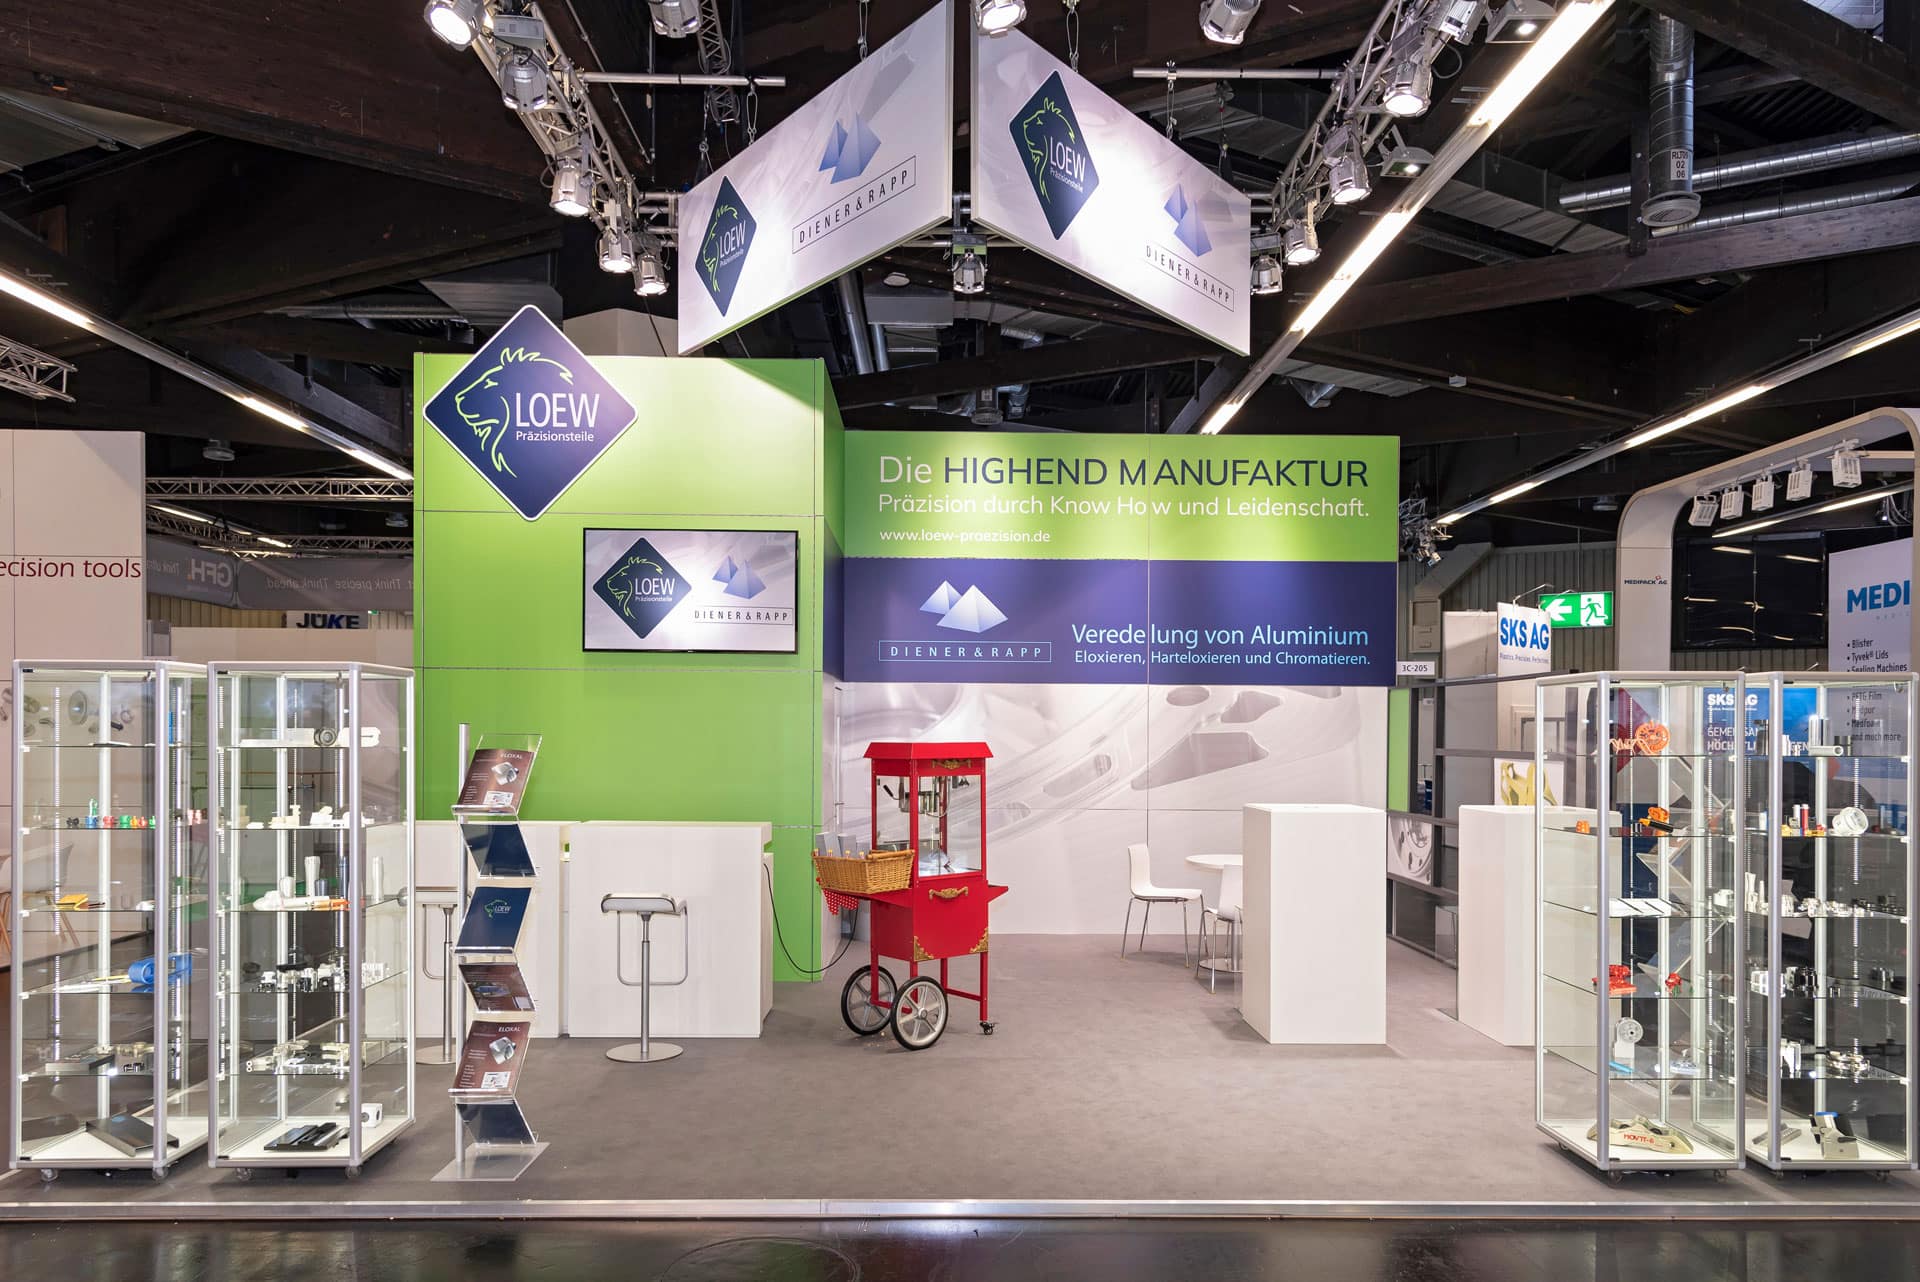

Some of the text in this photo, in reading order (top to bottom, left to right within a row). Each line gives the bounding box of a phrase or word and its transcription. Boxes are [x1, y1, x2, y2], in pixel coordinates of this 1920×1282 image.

[1050, 136, 1086, 183] LOEW
[1676, 161, 1685, 169] 02
[719, 219, 747, 259] LOEW
[516, 392, 600, 428] LOEW
[516, 430, 595, 442] Präzisionsteile
[879, 455, 933, 483] Die
[944, 456, 1108, 485] HIGHEND
[879, 493, 977, 513] Präzision
[983, 494, 1043, 514] durch
[1051, 495, 1111, 515] Know
[1179, 497, 1219, 516] und
[1227, 496, 1370, 518] Leidenschaft.
[879, 528, 1051, 543] www.loew-praezision.de
[83, 558, 142, 578] tools
[634, 577, 675, 596] LOEW
[1846, 580, 1911, 613] MEDI
[295, 612, 361, 630] JÜKE
[1072, 623, 1369, 649] Veredelung von Aluminium
[1500, 616, 1550, 651] SKS AG
[1851, 639, 1874, 649] Blister
[1075, 650, 1370, 665] Eloxieren, Harteloxieren und Chromatieren.
[1875, 650, 1889, 660] Lids
[1401, 664, 1428, 672] 3C-205
[1876, 662, 1908, 672] Machines
[1707, 693, 1736, 706] SKS
[494, 905, 512, 913] LOEW
